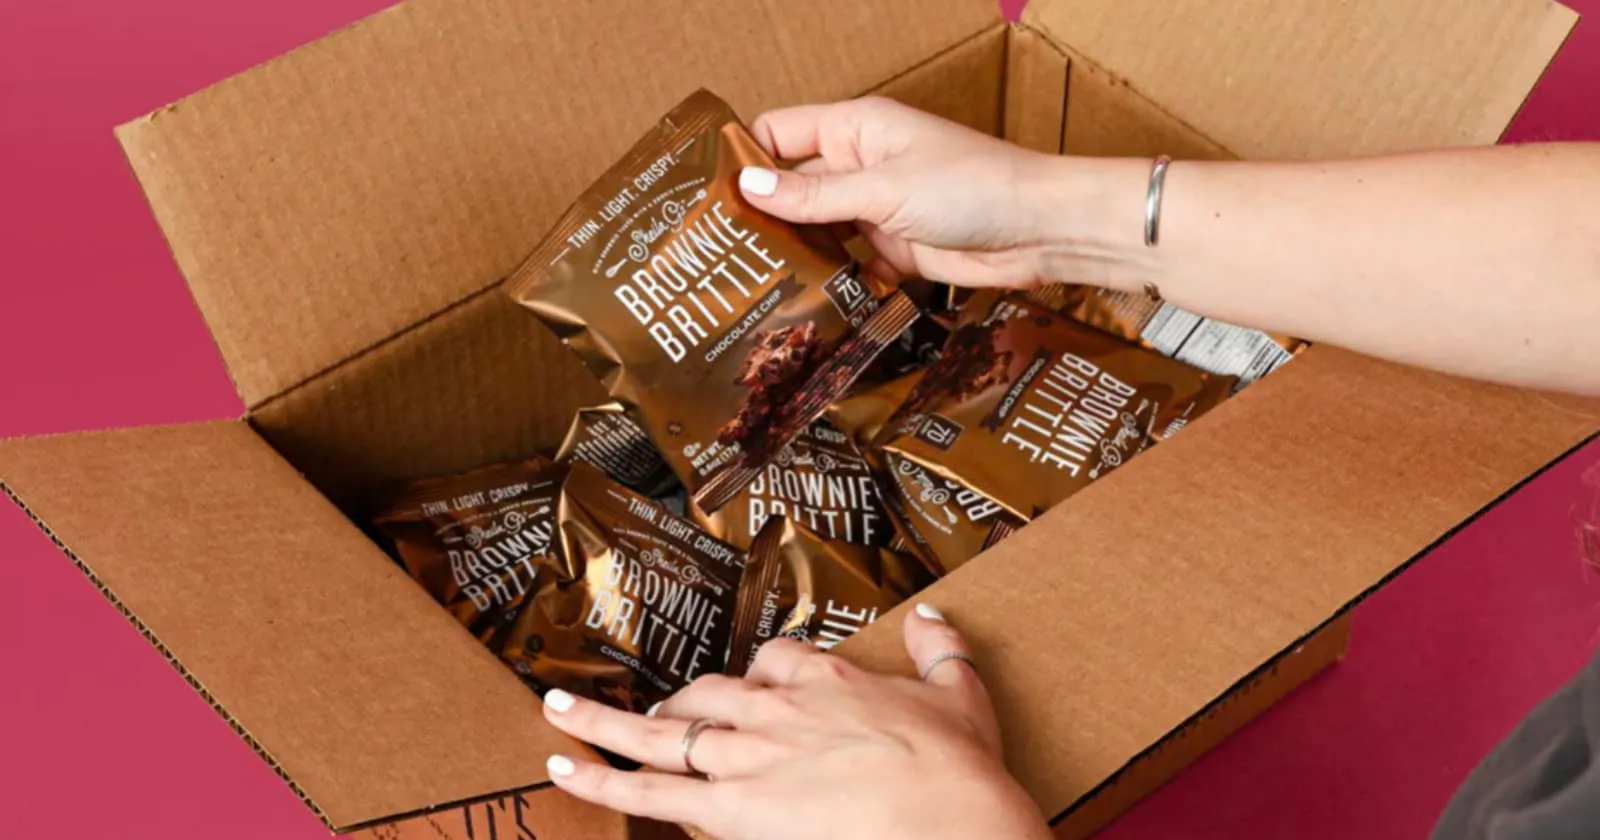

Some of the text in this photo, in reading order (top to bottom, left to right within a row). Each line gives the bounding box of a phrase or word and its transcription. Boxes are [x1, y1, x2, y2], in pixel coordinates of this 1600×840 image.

[598, 187, 639, 222] LIGHT.
[633, 152, 680, 192] CRISPY.
[613, 201, 749, 326] BROWNIE
[648, 233, 786, 364] BRITTLE
[704, 289, 782, 363] CHOCOLATE CHIP
[1002, 352, 1100, 463] BRITTLE
[1041, 372, 1137, 478] BROWNIE
[447, 520, 553, 587] BROWN
[627, 497, 657, 524] THIN.
[658, 514, 694, 545] LIGHT.
[693, 535, 736, 567] CRISPY.
[461, 545, 549, 613] BRIT
[602, 548, 723, 645] BROWNIE
[755, 589, 782, 638] CRISPY.
[584, 588, 712, 684] BRITTLE
